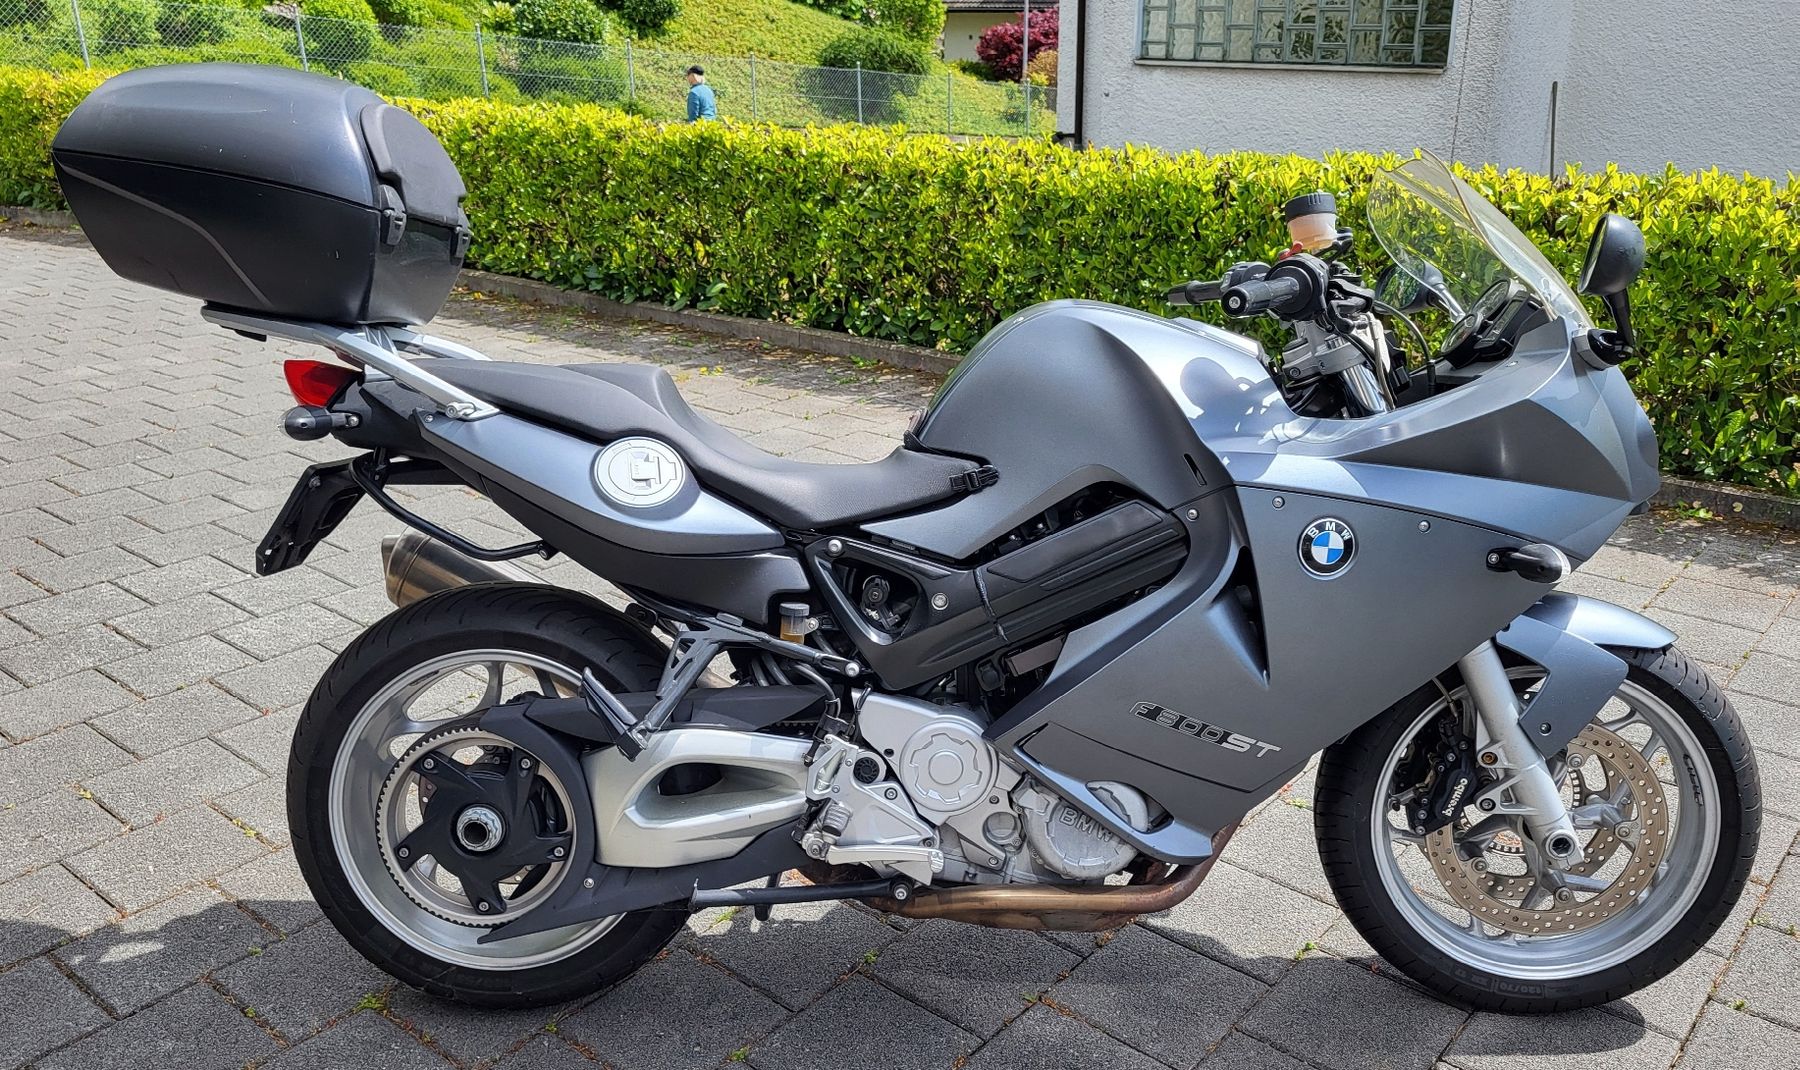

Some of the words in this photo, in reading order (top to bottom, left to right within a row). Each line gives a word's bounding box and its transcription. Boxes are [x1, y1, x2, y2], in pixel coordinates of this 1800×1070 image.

[1307, 521, 1352, 541] BMW
[1442, 778, 1468, 817] brembo
[1060, 807, 1114, 842] BMW
